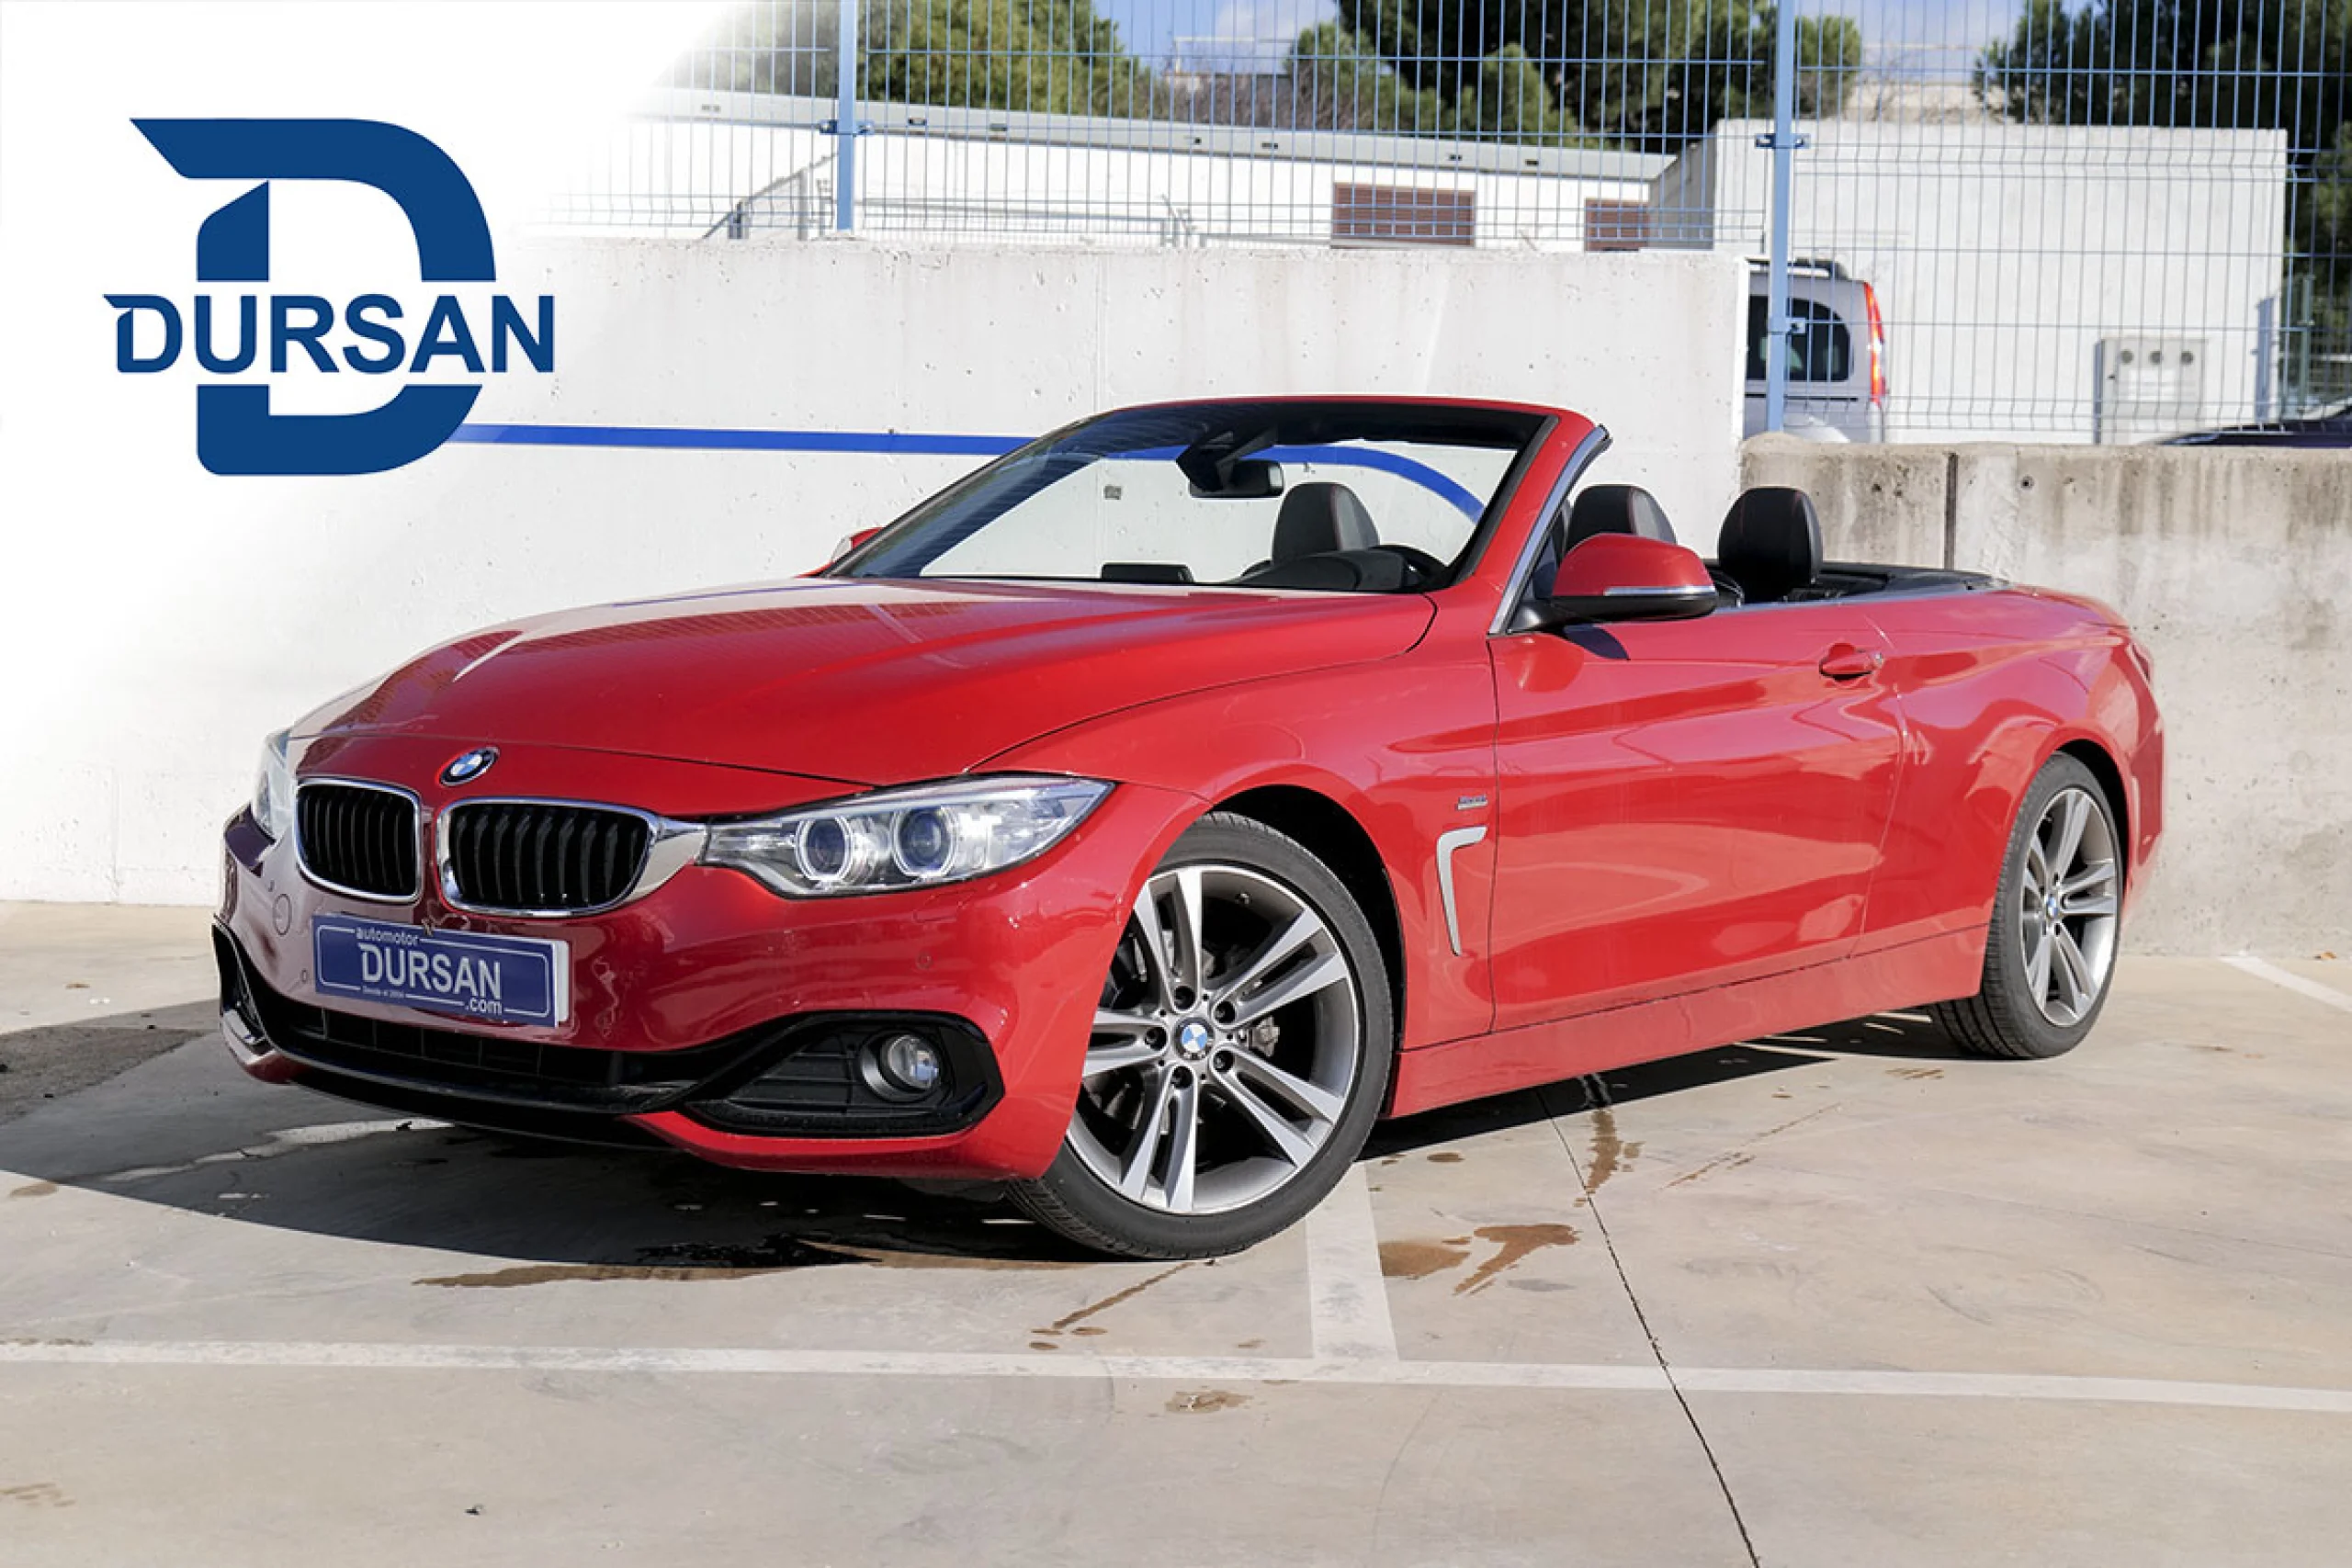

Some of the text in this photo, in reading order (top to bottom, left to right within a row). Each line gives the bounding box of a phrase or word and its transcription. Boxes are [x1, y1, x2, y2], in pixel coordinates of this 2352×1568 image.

[356, 927, 419, 945] automotor
[357, 942, 502, 999] DURSAN
[465, 997, 503, 1014] .com
